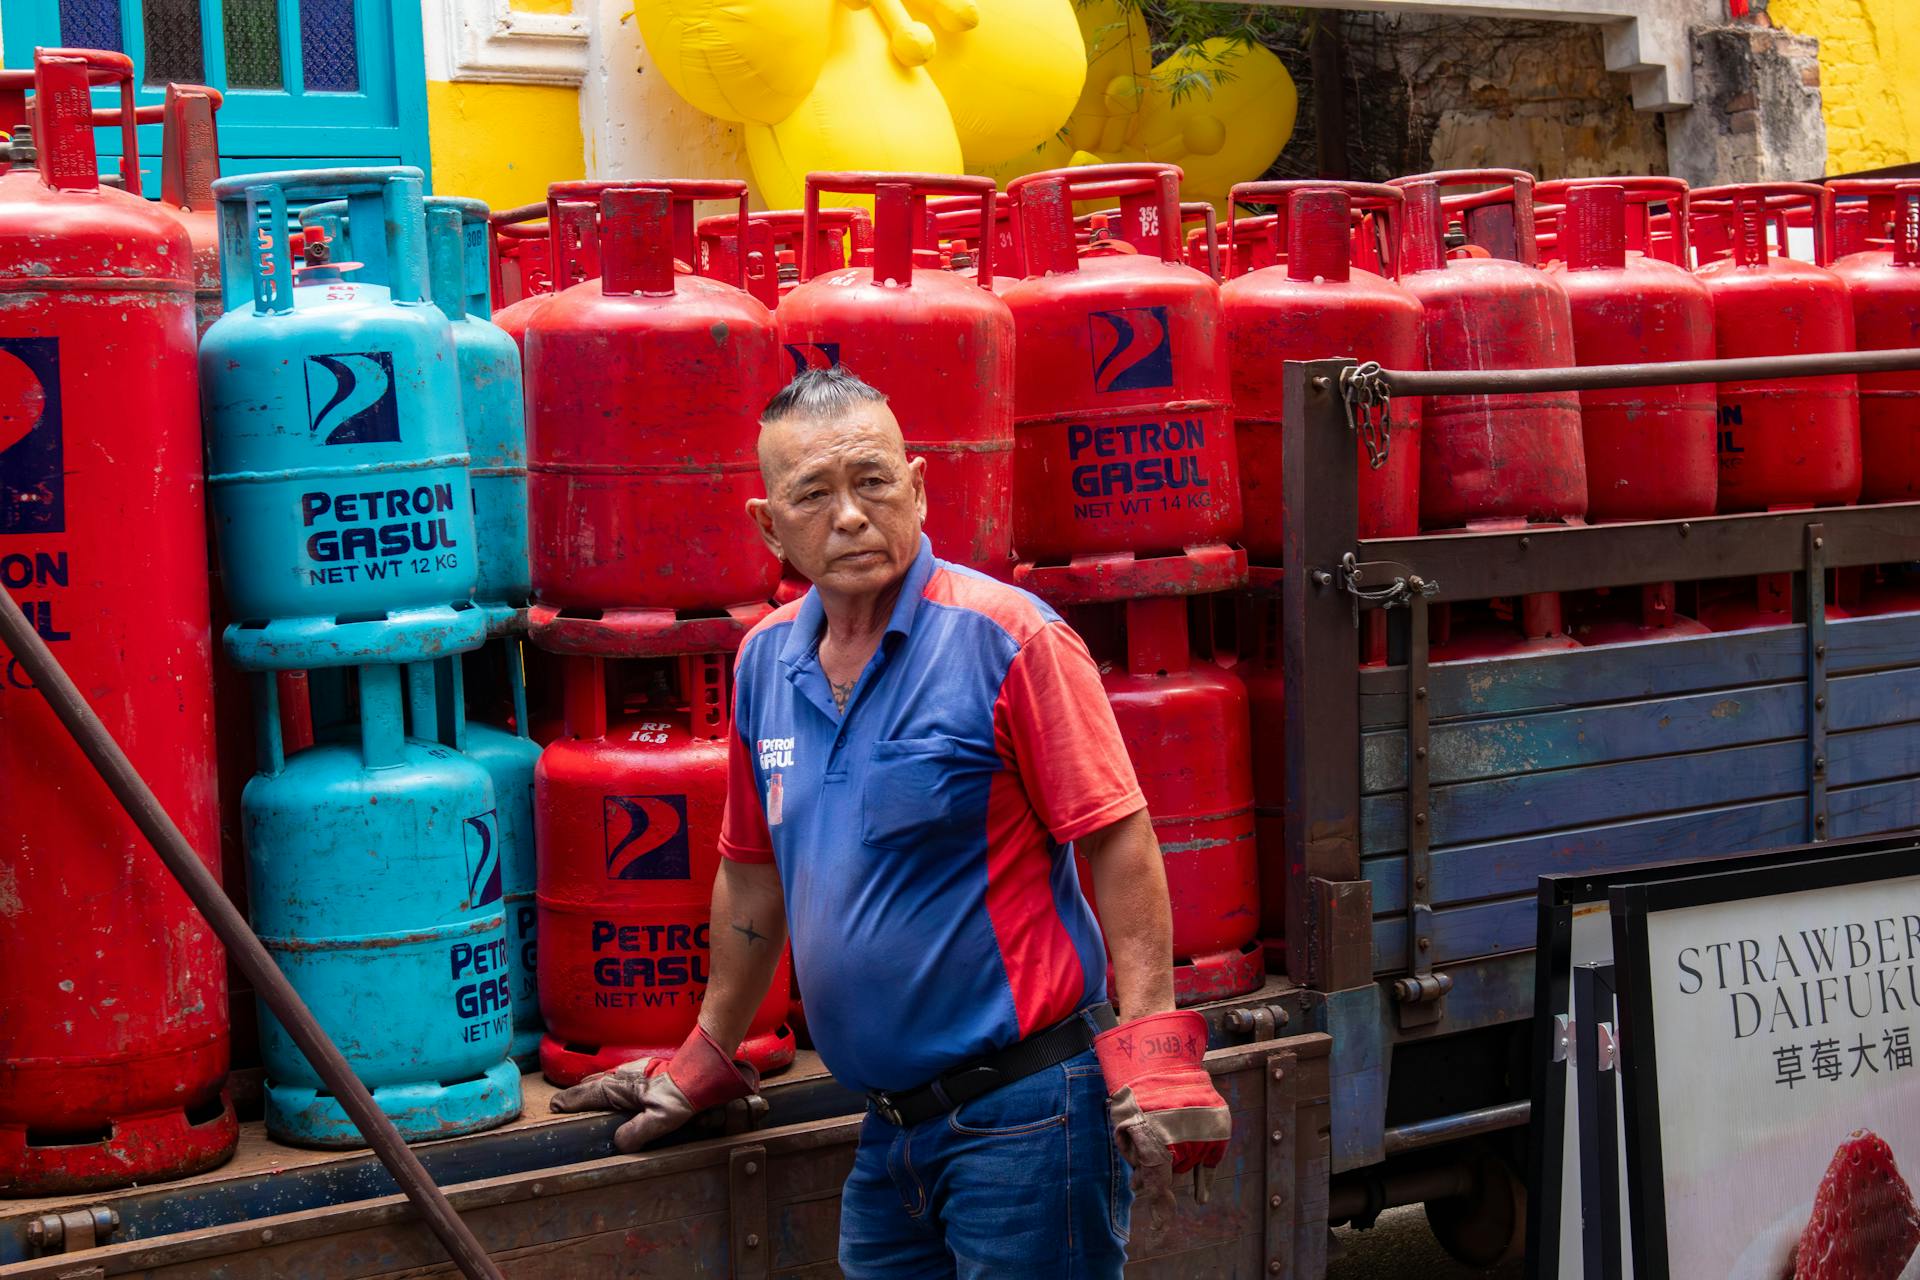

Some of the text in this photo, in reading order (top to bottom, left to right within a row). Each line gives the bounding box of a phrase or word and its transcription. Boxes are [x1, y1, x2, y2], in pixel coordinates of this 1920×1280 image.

[1068, 418, 1206, 462] PETRON
[1072, 455, 1209, 498] GASUL
[301, 482, 455, 527] PETRON
[1073, 492, 1213, 520] NET WT 14 KG
[306, 518, 457, 563] GASUL
[309, 553, 458, 586] NET WT 12 KG
[627, 731, 669, 744] 16.8
[640, 722, 672, 731] RP
[595, 991, 638, 1008] NET
[642, 991, 680, 1008] WT
[1144, 1035, 1182, 1057] EPIC
[1772, 1026, 1914, 1090] 草莓大福
